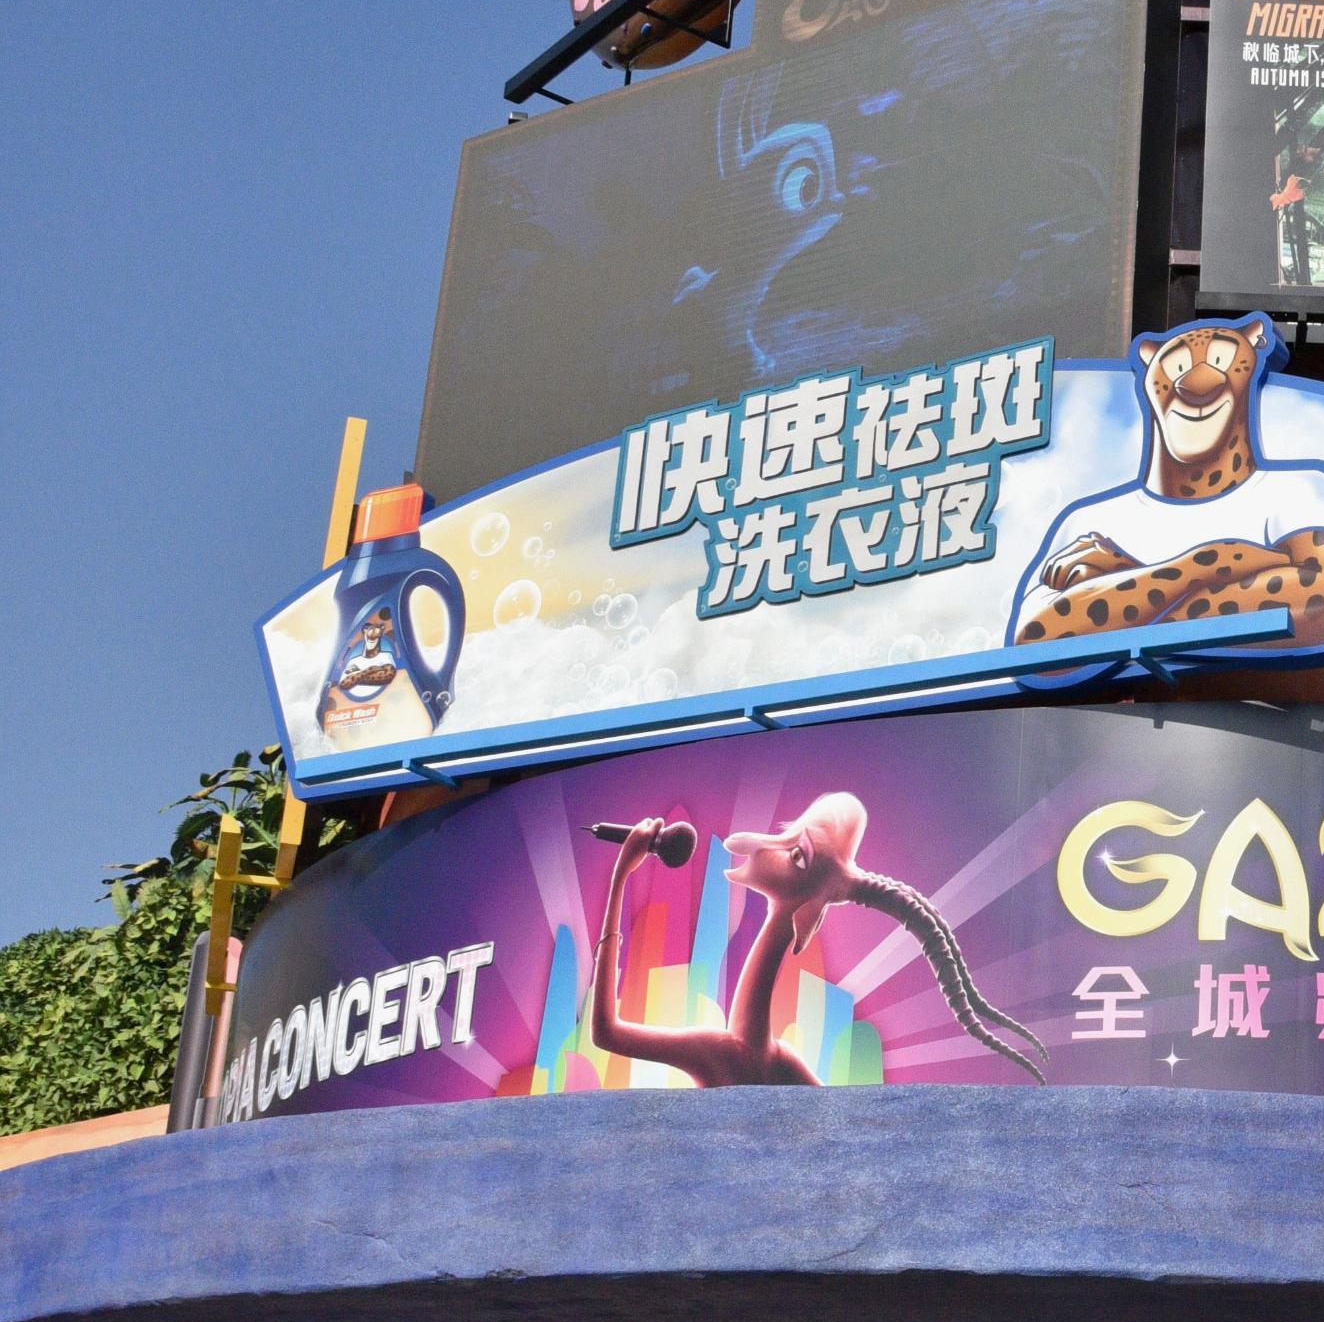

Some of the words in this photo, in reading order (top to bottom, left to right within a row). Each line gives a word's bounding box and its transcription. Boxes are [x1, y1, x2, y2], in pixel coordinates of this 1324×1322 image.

[1251, 68, 1309, 87] AUTUMN
[618, 345, 1045, 533] 快速祛斑
[708, 462, 990, 608] 洗衣液
[218, 1037, 258, 1125] PIA
[257, 941, 494, 1112] CONCERT
